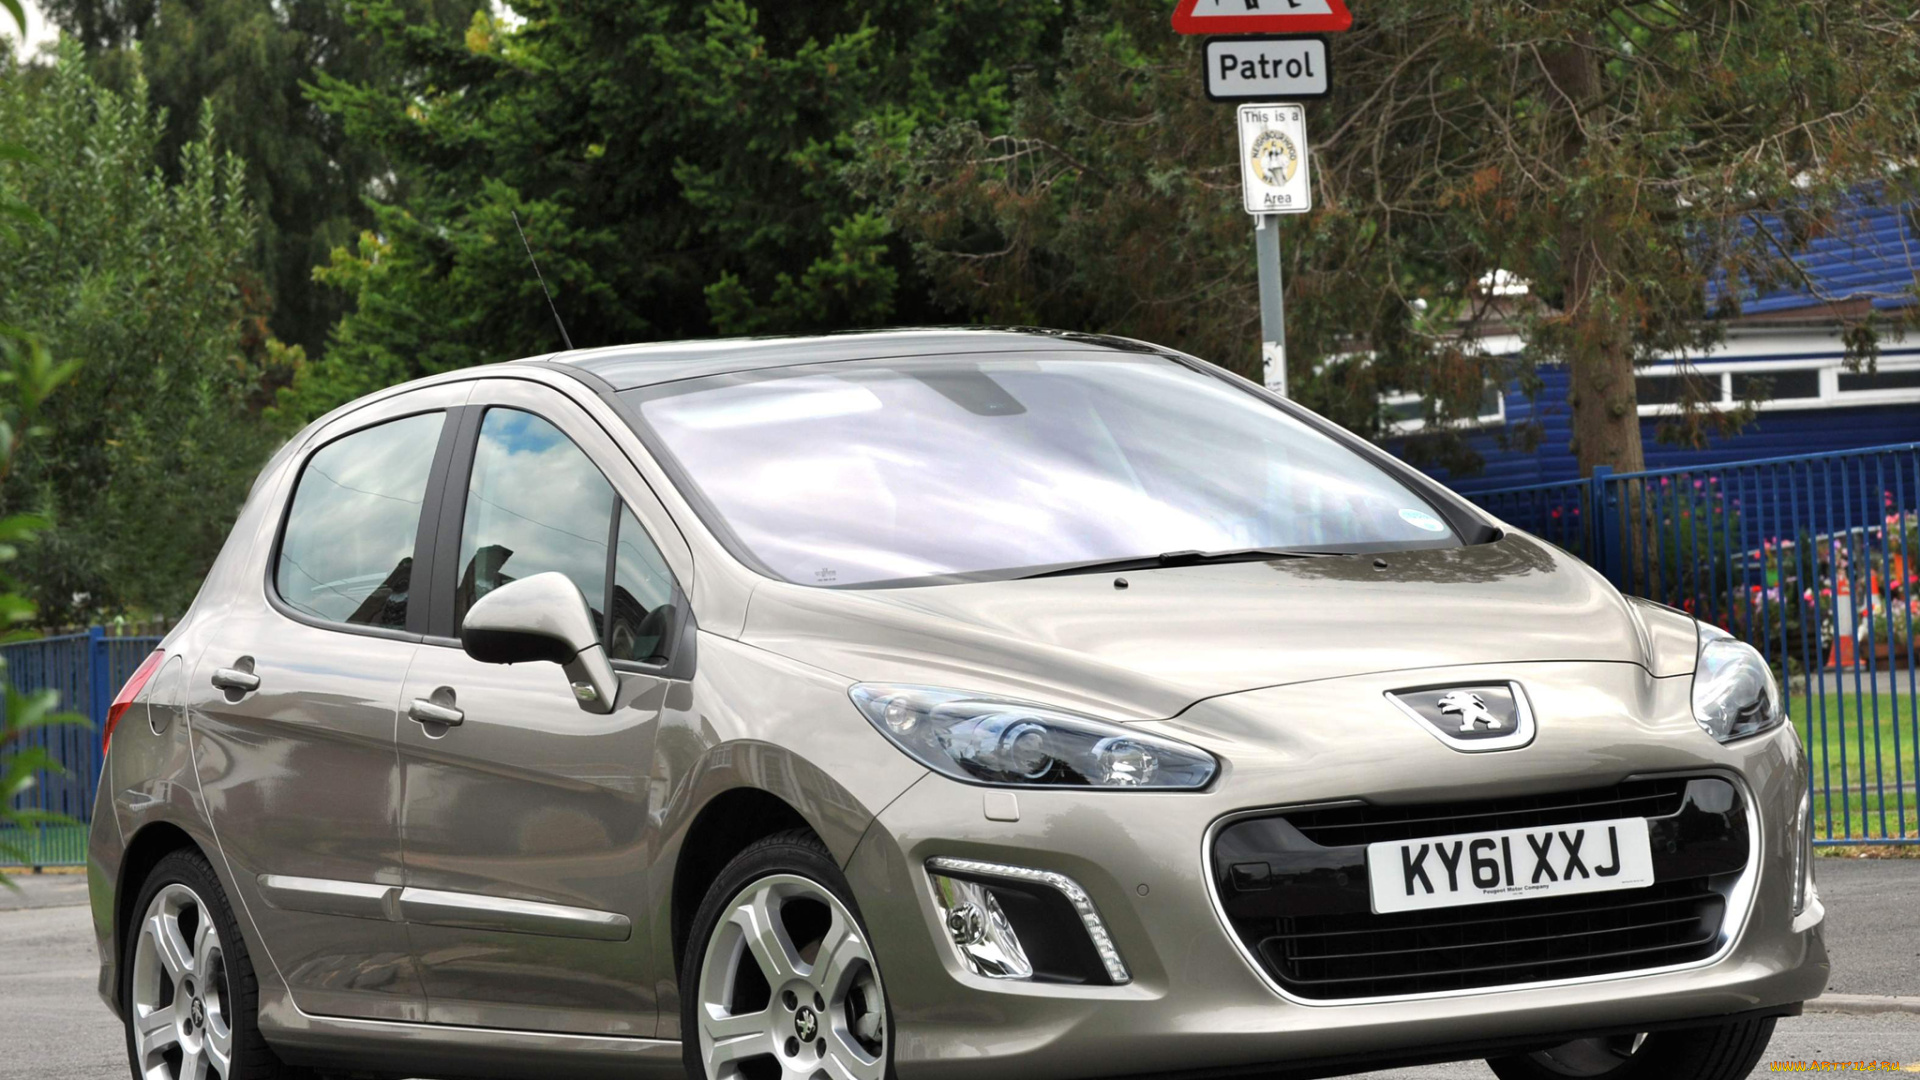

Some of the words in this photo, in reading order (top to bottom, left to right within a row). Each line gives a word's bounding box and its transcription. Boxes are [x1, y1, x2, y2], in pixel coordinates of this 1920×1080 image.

[1220, 51, 1314, 80] Patrol
[1244, 111, 1269, 123] This
[1275, 111, 1285, 121] is
[1292, 113, 1299, 121] a
[1252, 130, 1297, 161] NEIGHBOURHOOD
[1264, 193, 1292, 204] Area
[1400, 836, 1515, 896] KY61
[1526, 826, 1621, 884] XXJ
